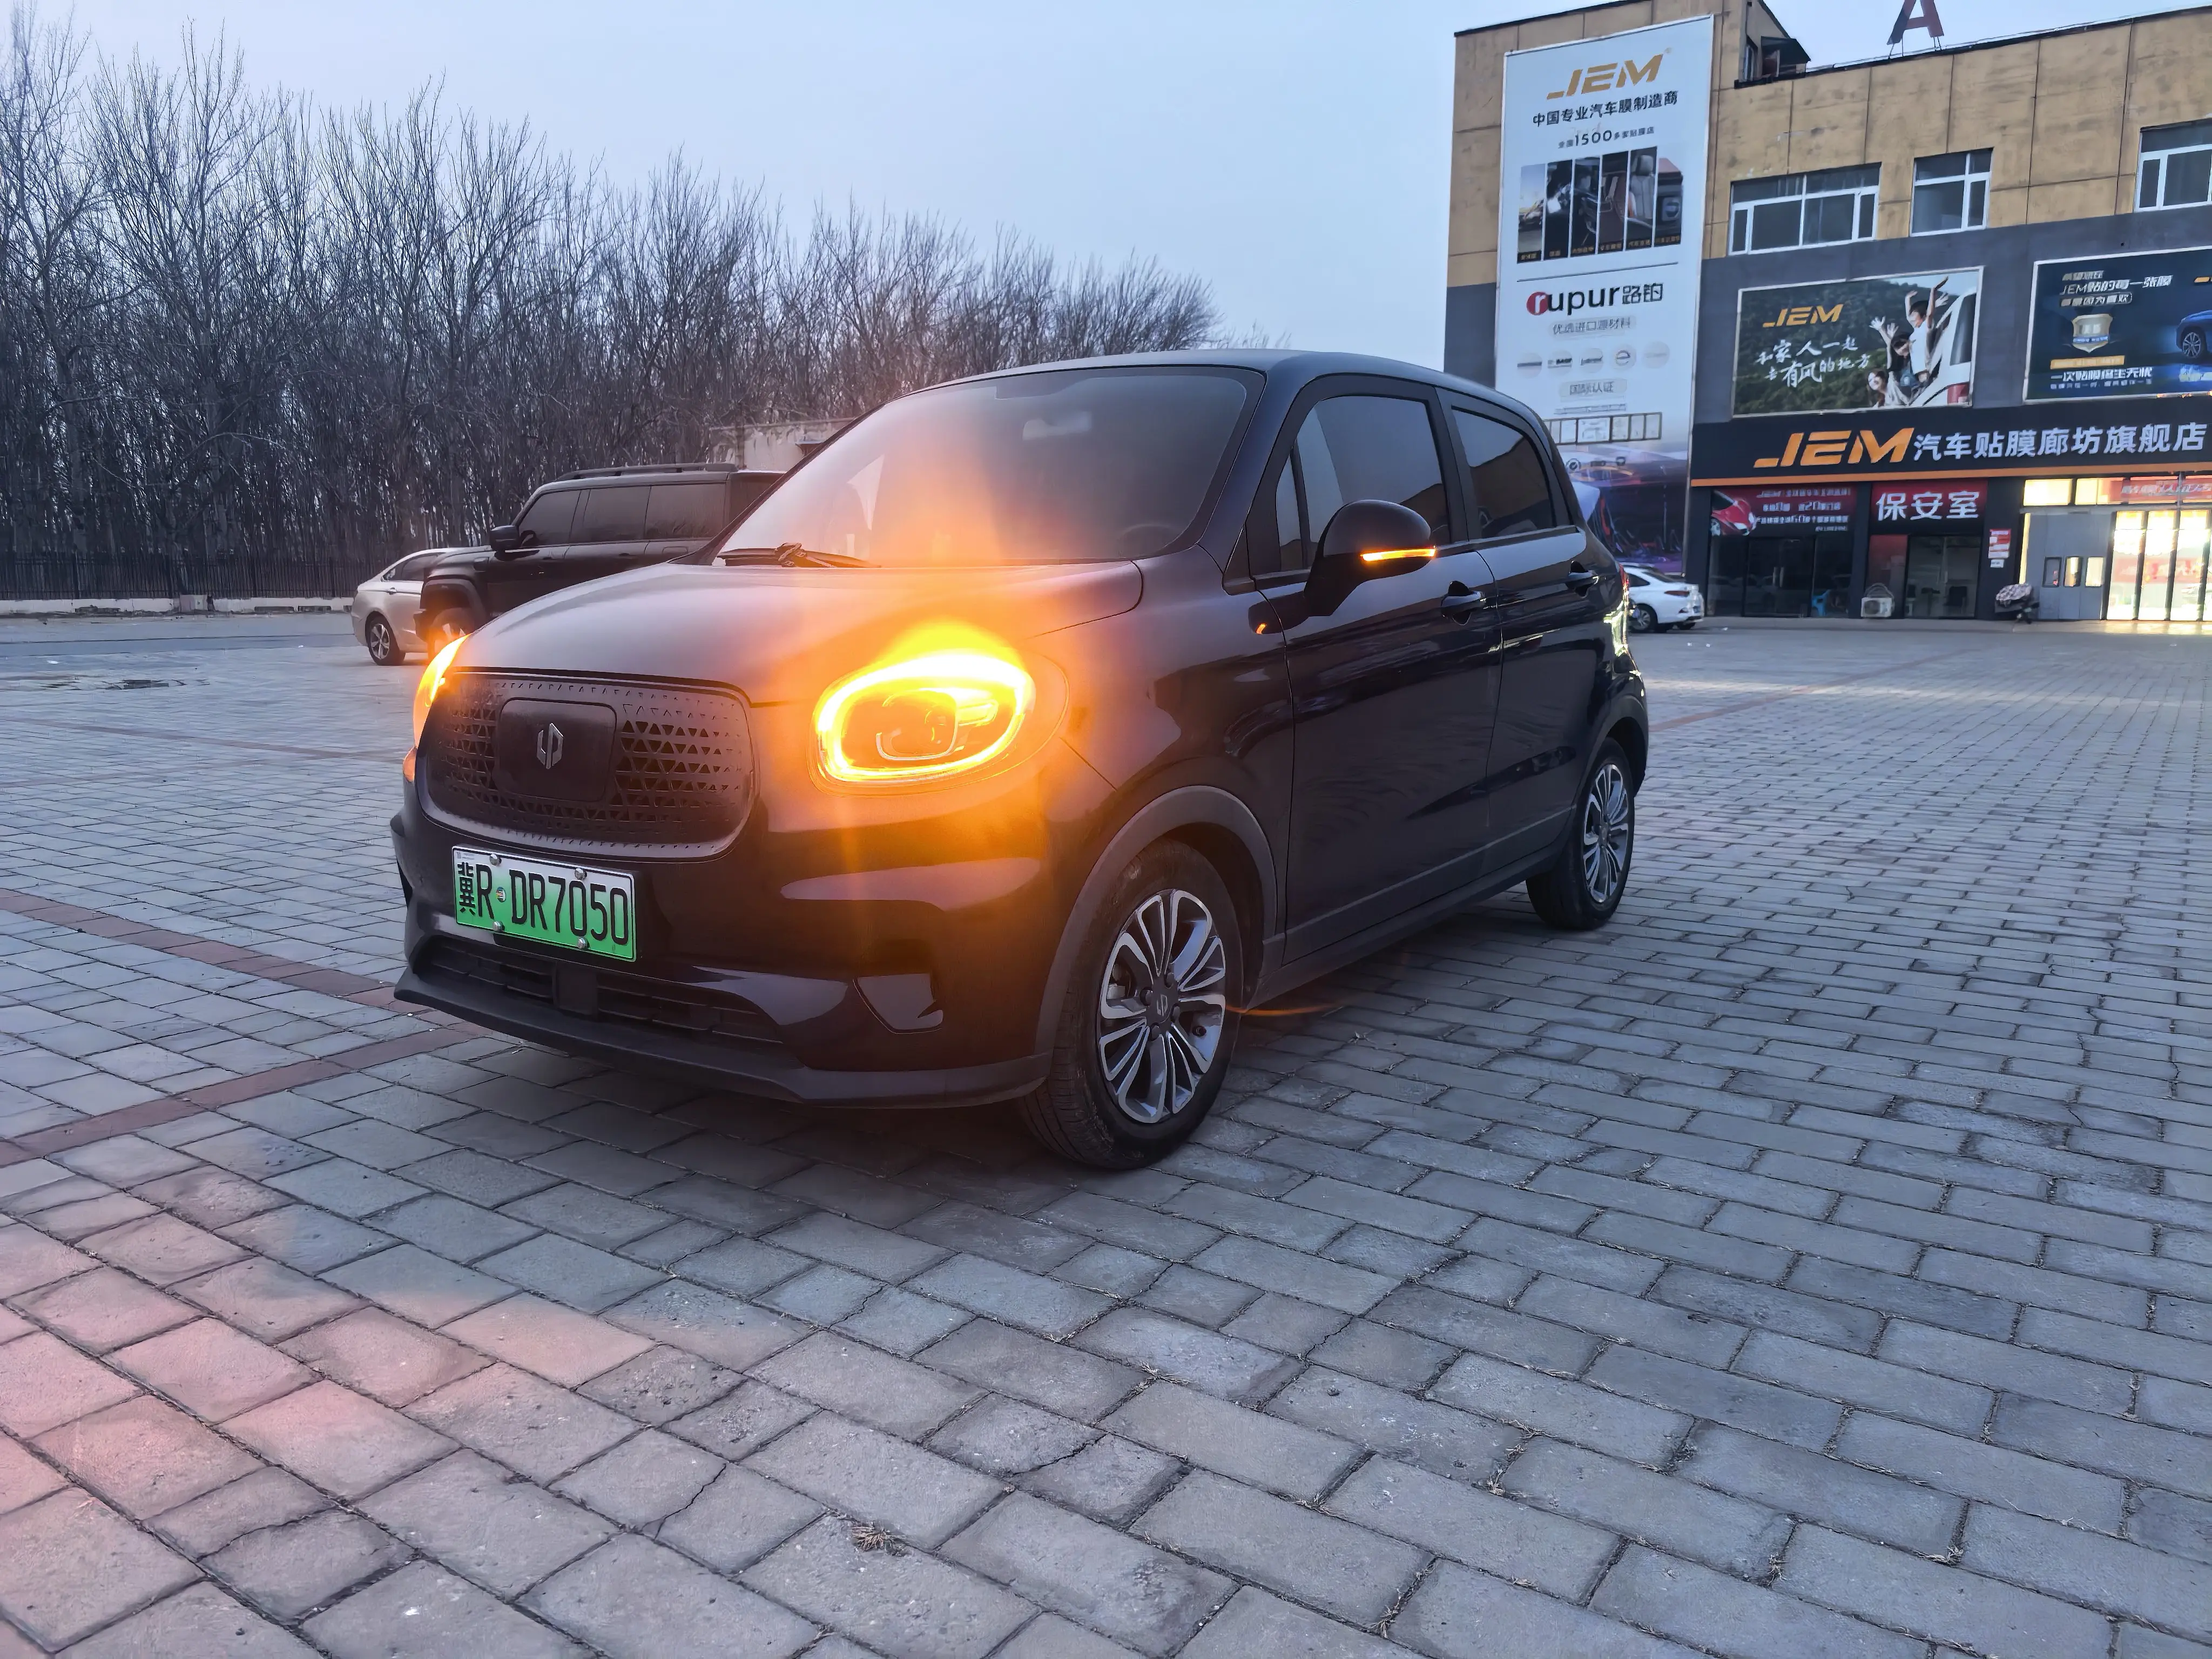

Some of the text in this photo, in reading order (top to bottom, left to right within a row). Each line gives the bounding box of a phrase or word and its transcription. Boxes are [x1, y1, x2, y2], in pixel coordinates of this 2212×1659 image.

[1887, 0, 1944, 45] A
[1547, 54, 1664, 99] JEM
[1533, 90, 1678, 127] 中国专业汽车膜制造商
[1762, 304, 1844, 328] JEM
[1755, 334, 1858, 365] 和家人一起
[1764, 353, 1871, 388] 去有风的地方
[1754, 422, 2208, 468] JEM 汽车贴膜廊坊旗舰店
[1876, 490, 1980, 521] 保安室
